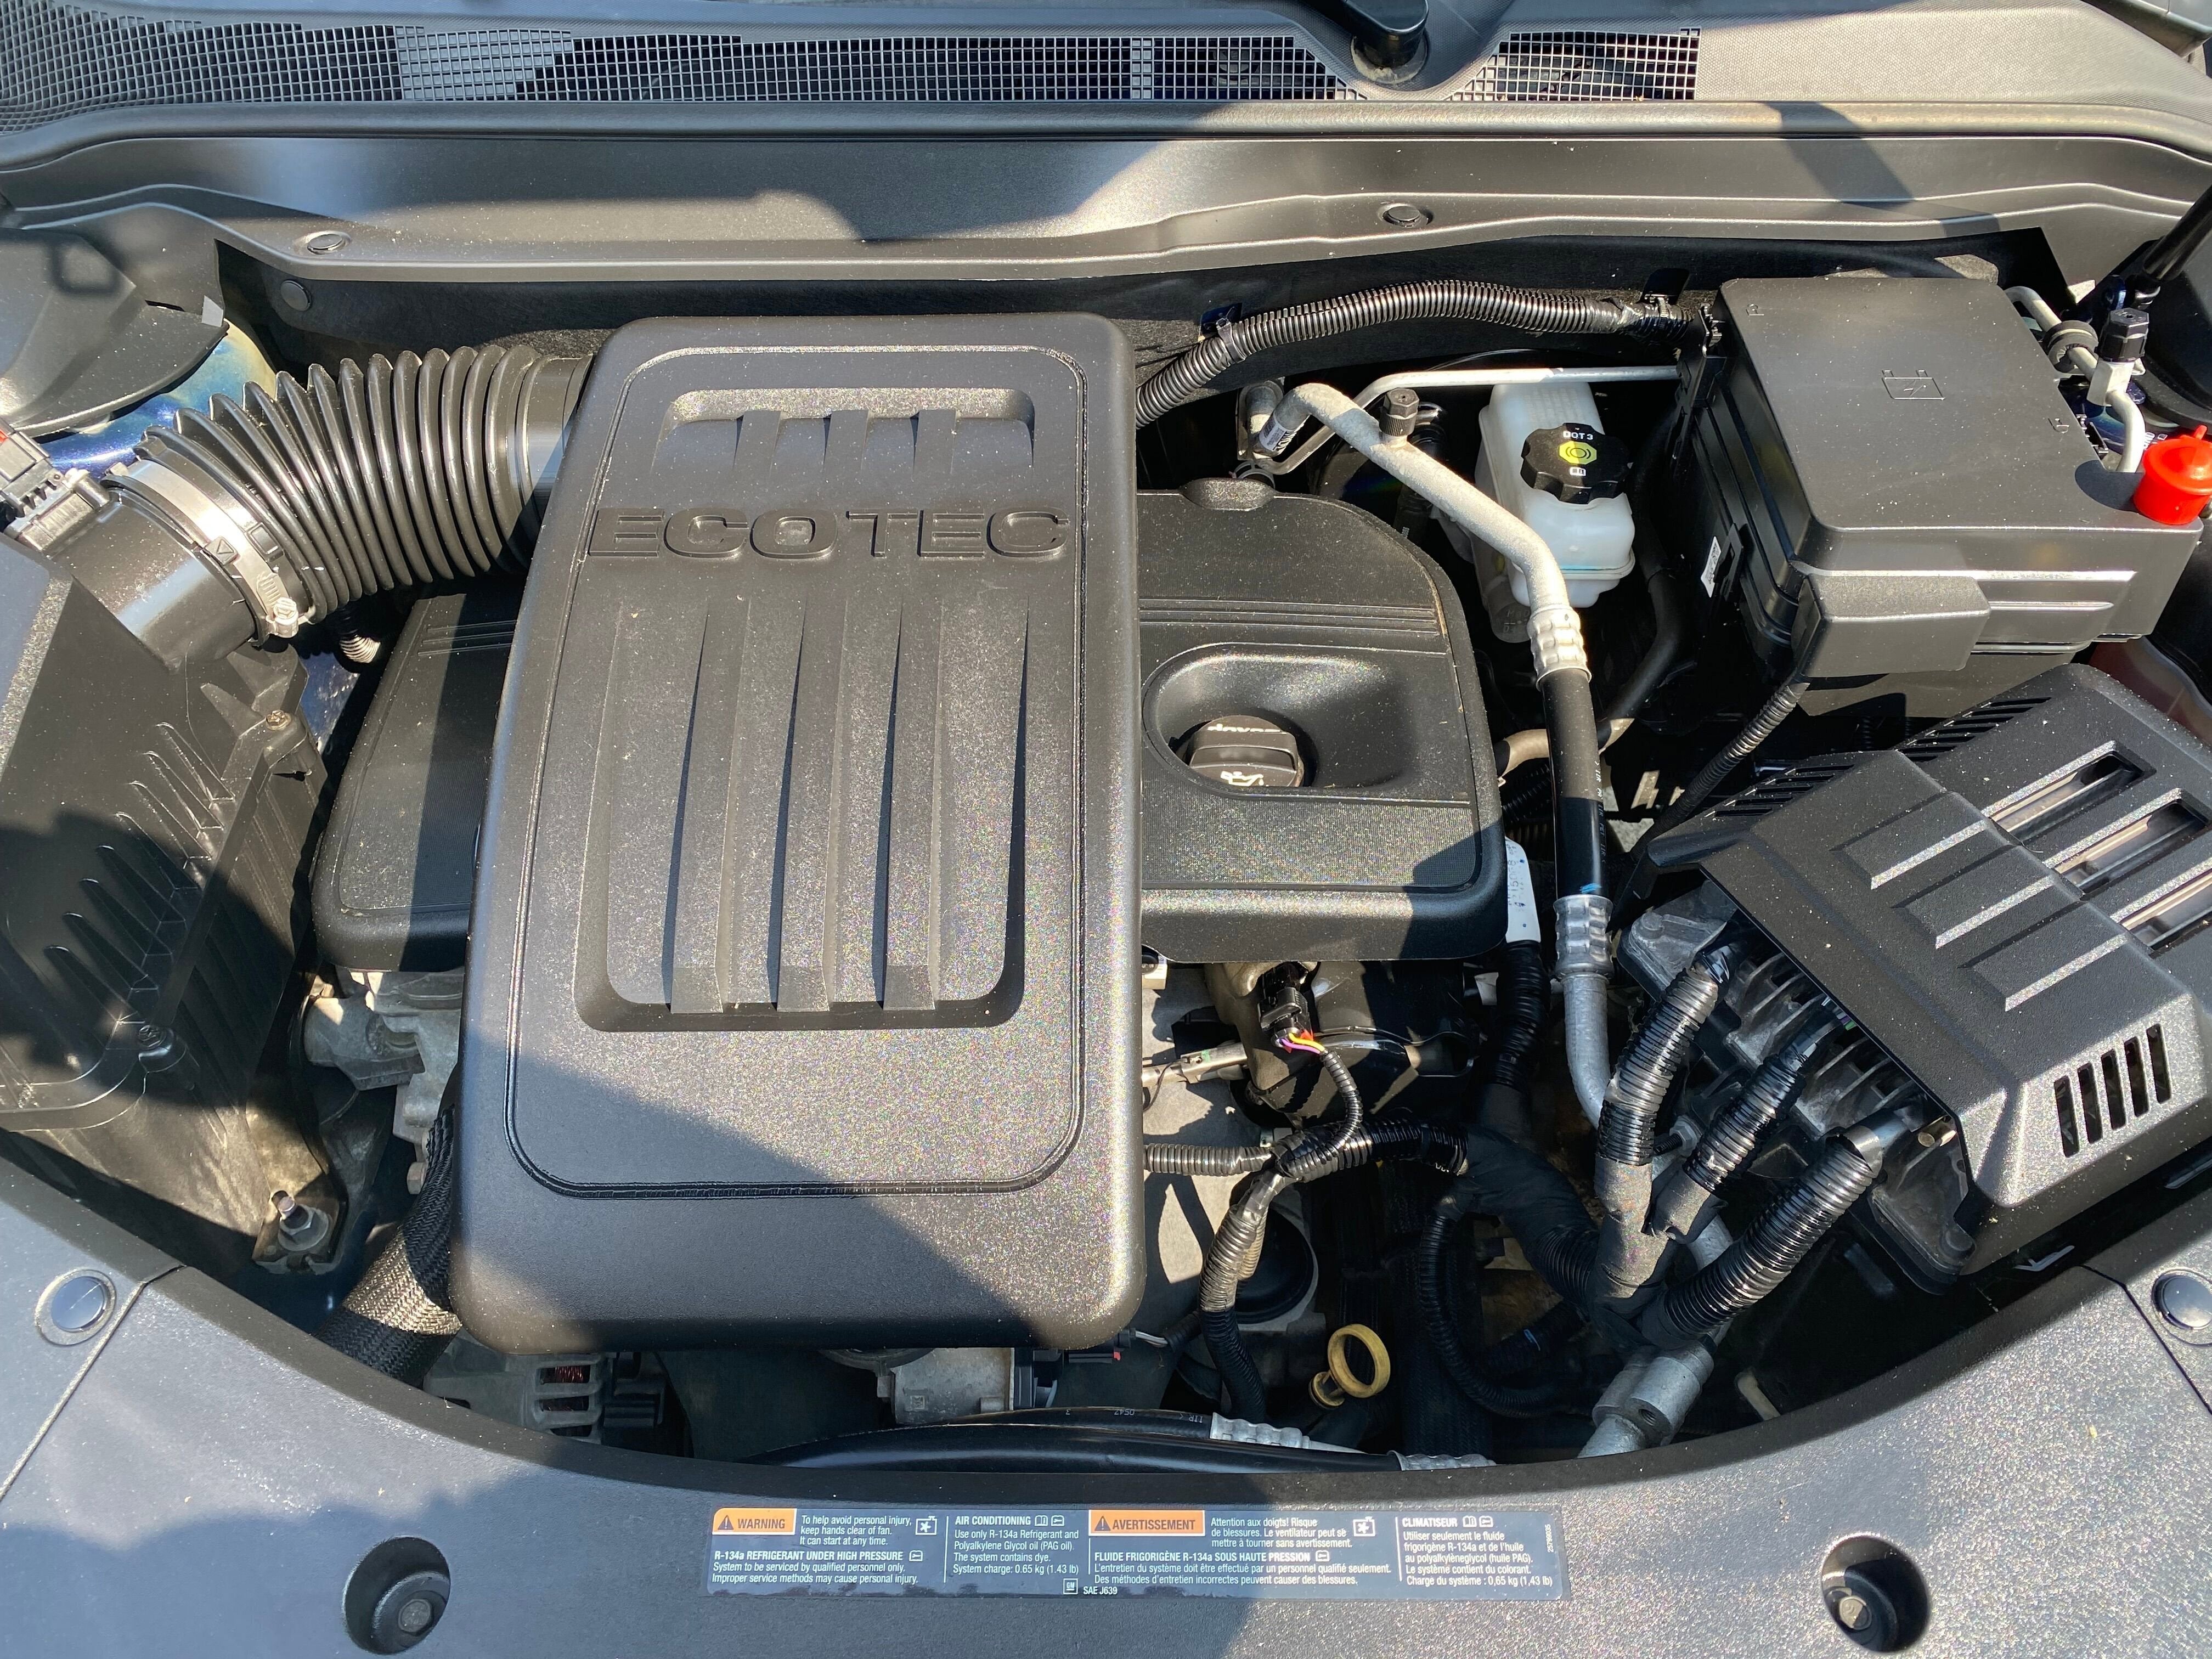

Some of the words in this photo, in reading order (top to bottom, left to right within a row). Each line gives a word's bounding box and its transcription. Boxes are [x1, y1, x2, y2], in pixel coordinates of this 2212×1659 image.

[1563, 431, 1585, 439] DOT
[588, 507, 1070, 559] ECOTEC
[738, 1519, 785, 1529] WARNING
[802, 1515, 810, 1524] To
[812, 1515, 828, 1526] help
[831, 1516, 851, 1525] avoid
[854, 1516, 886, 1526] personal
[888, 1516, 912, 1527] injury,
[955, 1516, 969, 1525] AIR
[972, 1516, 1031, 1525] CONDITIONING
[1113, 1520, 1195, 1530] AVERTISSEMENT
[1211, 1518, 1245, 1526] Attention
[1263, 1518, 1289, 1527] doigts!
[1291, 1518, 1317, 1528] Risque
[1402, 1518, 1458, 1527] CLIMATISEUR
[800, 1526, 820, 1536] keep
[822, 1526, 844, 1534] hands
[847, 1526, 866, 1534] clear
[868, 1526, 876, 1534] of
[878, 1526, 892, 1535] fan.
[955, 1530, 969, 1538] Use
[971, 1530, 987, 1540] only
[990, 1530, 1017, 1538] R-134a
[1020, 1530, 1062, 1540] Refrigerant
[1064, 1530, 1079, 1538] and
[1211, 1528, 1221, 1537] de
[1223, 1528, 1262, 1537] blessures.
[1264, 1528, 1273, 1537] Le
[1276, 1528, 1316, 1537] ventilateur
[1318, 1529, 1335, 1538] peut
[1403, 1531, 1430, 1541] Utiliser
[1432, 1531, 1472, 1541] seulement
[1474, 1531, 1482, 1541] le
[800, 1537, 805, 1545] It
[869, 1537, 888, 1545] time.
[954, 1541, 1002, 1551] Polyalkylene
[1004, 1541, 1027, 1551] Glycol
[1029, 1542, 1038, 1550] oil
[1040, 1541, 1058, 1551] (PAG
[1061, 1542, 1074, 1551] oil).
[1212, 1539, 1237, 1547] mettre
[1239, 1538, 1244, 1547] à
[1296, 1539, 1352, 1548] avertissement.
[1404, 1543, 1445, 1553] frigorigène
[1448, 1543, 1477, 1551] R-134a
[1479, 1543, 1486, 1551] et
[1488, 1543, 1498, 1551] de
[1500, 1543, 1524, 1551] l'huile
[714, 1551, 744, 1560] R-134a
[747, 1551, 804, 1560] REFRIGERANT
[806, 1551, 834, 1560] UNDER
[837, 1551, 857, 1560] HIGH
[859, 1551, 903, 1560] PRESSURE
[954, 1553, 968, 1561] The
[970, 1554, 998, 1564] system
[1000, 1553, 1032, 1562] contains
[1035, 1553, 1051, 1564] dye.
[1094, 1552, 1124, 1561] FLUIDE
[1126, 1550, 1180, 1561] FRIGORIGÈNE
[1183, 1553, 1212, 1561] R-134a
[1215, 1553, 1237, 1561] SOUS
[1239, 1553, 1266, 1561] HAUTE
[1268, 1553, 1311, 1561] PRESSION
[1489, 1554, 1511, 1564] (huile
[1513, 1554, 1533, 1564] PAG).
[713, 1562, 742, 1572] System
[744, 1563, 751, 1571] to
[754, 1562, 764, 1571] be
[766, 1562, 799, 1571] serviced
[801, 1562, 810, 1573] by
[812, 1562, 845, 1573] qualified
[848, 1563, 885, 1573] personnel
[888, 1563, 905, 1573] only.
[953, 1564, 981, 1575] System
[984, 1565, 1013, 1575] charge:
[1015, 1565, 1032, 1573] 0.65
[1035, 1565, 1044, 1575] kg
[1047, 1565, 1066, 1575] (1.43
[1069, 1565, 1079, 1575] lb)
[1094, 1564, 1135, 1572] L'entretien
[1137, 1564, 1147, 1572] du
[1184, 1564, 1198, 1572] doit
[1200, 1564, 1215, 1572] être
[1218, 1564, 1249, 1573] effectué
[1251, 1566, 1263, 1574] par
[1278, 1564, 1316, 1574] personnel
[1348, 1564, 1391, 1573] seulement.
[1406, 1565, 1415, 1574] Le
[1452, 1565, 1484, 1574] contient
[1486, 1565, 1495, 1574] du
[1497, 1565, 1531, 1574] colorant.
[713, 1573, 747, 1583] Improper
[749, 1574, 777, 1583] service
[780, 1573, 813, 1583] methods
[815, 1575, 832, 1584] may
[834, 1575, 857, 1583] cause
[859, 1574, 892, 1584] personal
[894, 1574, 918, 1585] injury.
[1094, 1575, 1109, 1584] Des
[1112, 1575, 1149, 1584] méthodes
[1152, 1575, 1193, 1584] d'entretien
[1196, 1575, 1238, 1584] incorrectes
[1241, 1576, 1272, 1585] peuvent
[1274, 1576, 1300, 1584] causer
[1302, 1576, 1316, 1584] des
[1437, 1576, 1447, 1585] du
[1488, 1576, 1506, 1585] 0,65
[1509, 1576, 1518, 1587] kg
[1520, 1576, 1540, 1587] (1,43
[1543, 1576, 1553, 1587] lb)
[1084, 1587, 1098, 1595] SAE
[1099, 1587, 1118, 1595] J639
